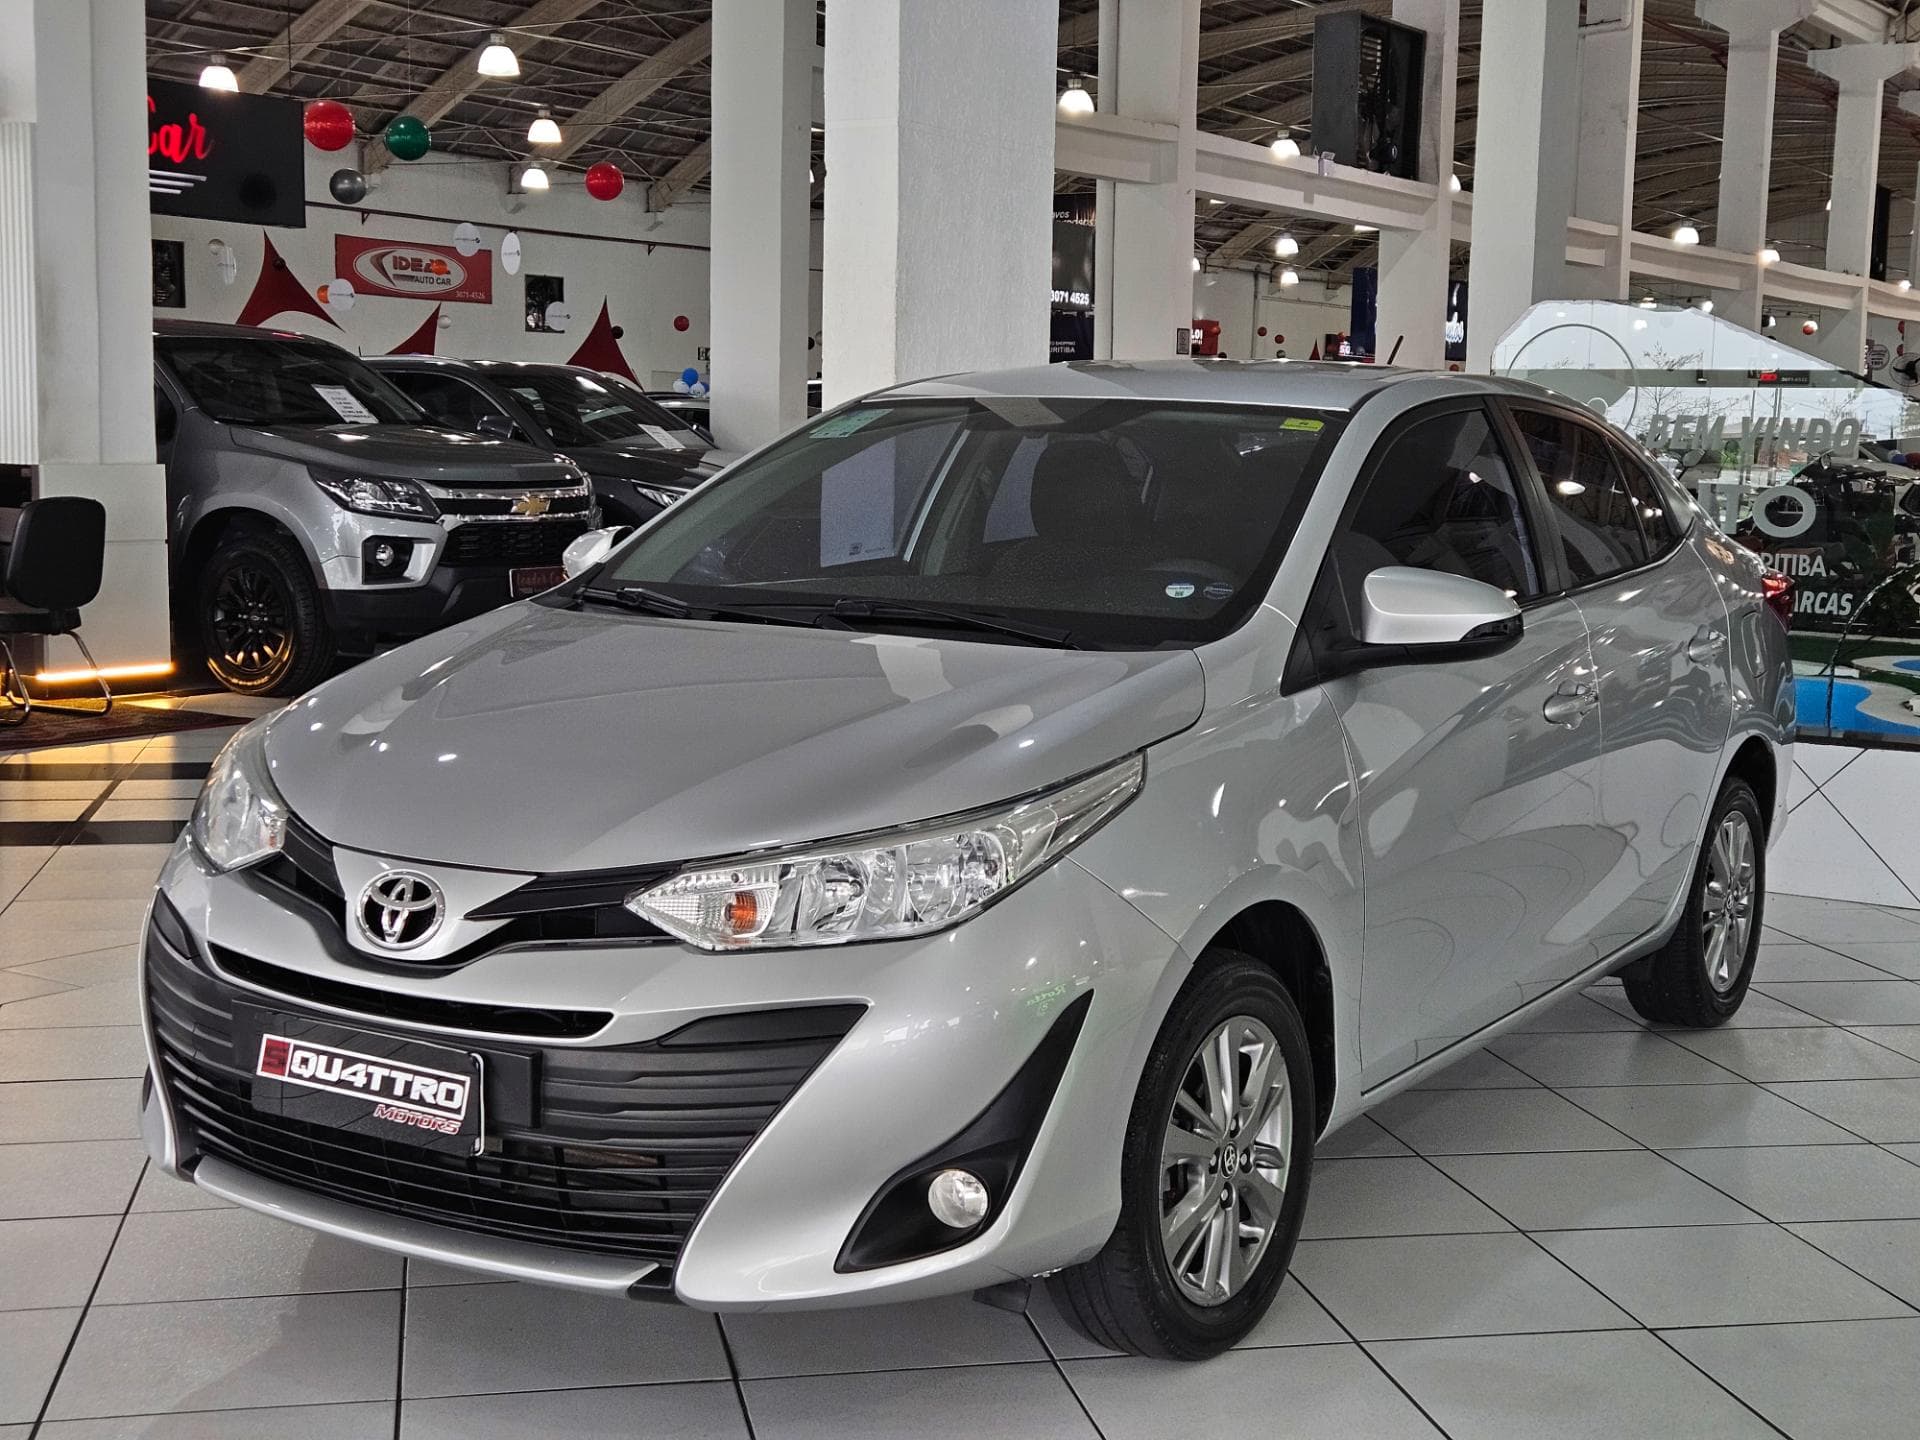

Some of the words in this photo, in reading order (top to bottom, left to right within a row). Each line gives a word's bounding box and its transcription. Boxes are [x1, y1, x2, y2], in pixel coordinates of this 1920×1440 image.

[414, 275, 435, 285] AUTO
[436, 277, 451, 285] CAR
[1646, 414, 1726, 451] BEM
[1741, 416, 1860, 456] VINDO
[290, 1049, 465, 1110] QU4TTRO
[372, 1103, 462, 1135] MOTORS
